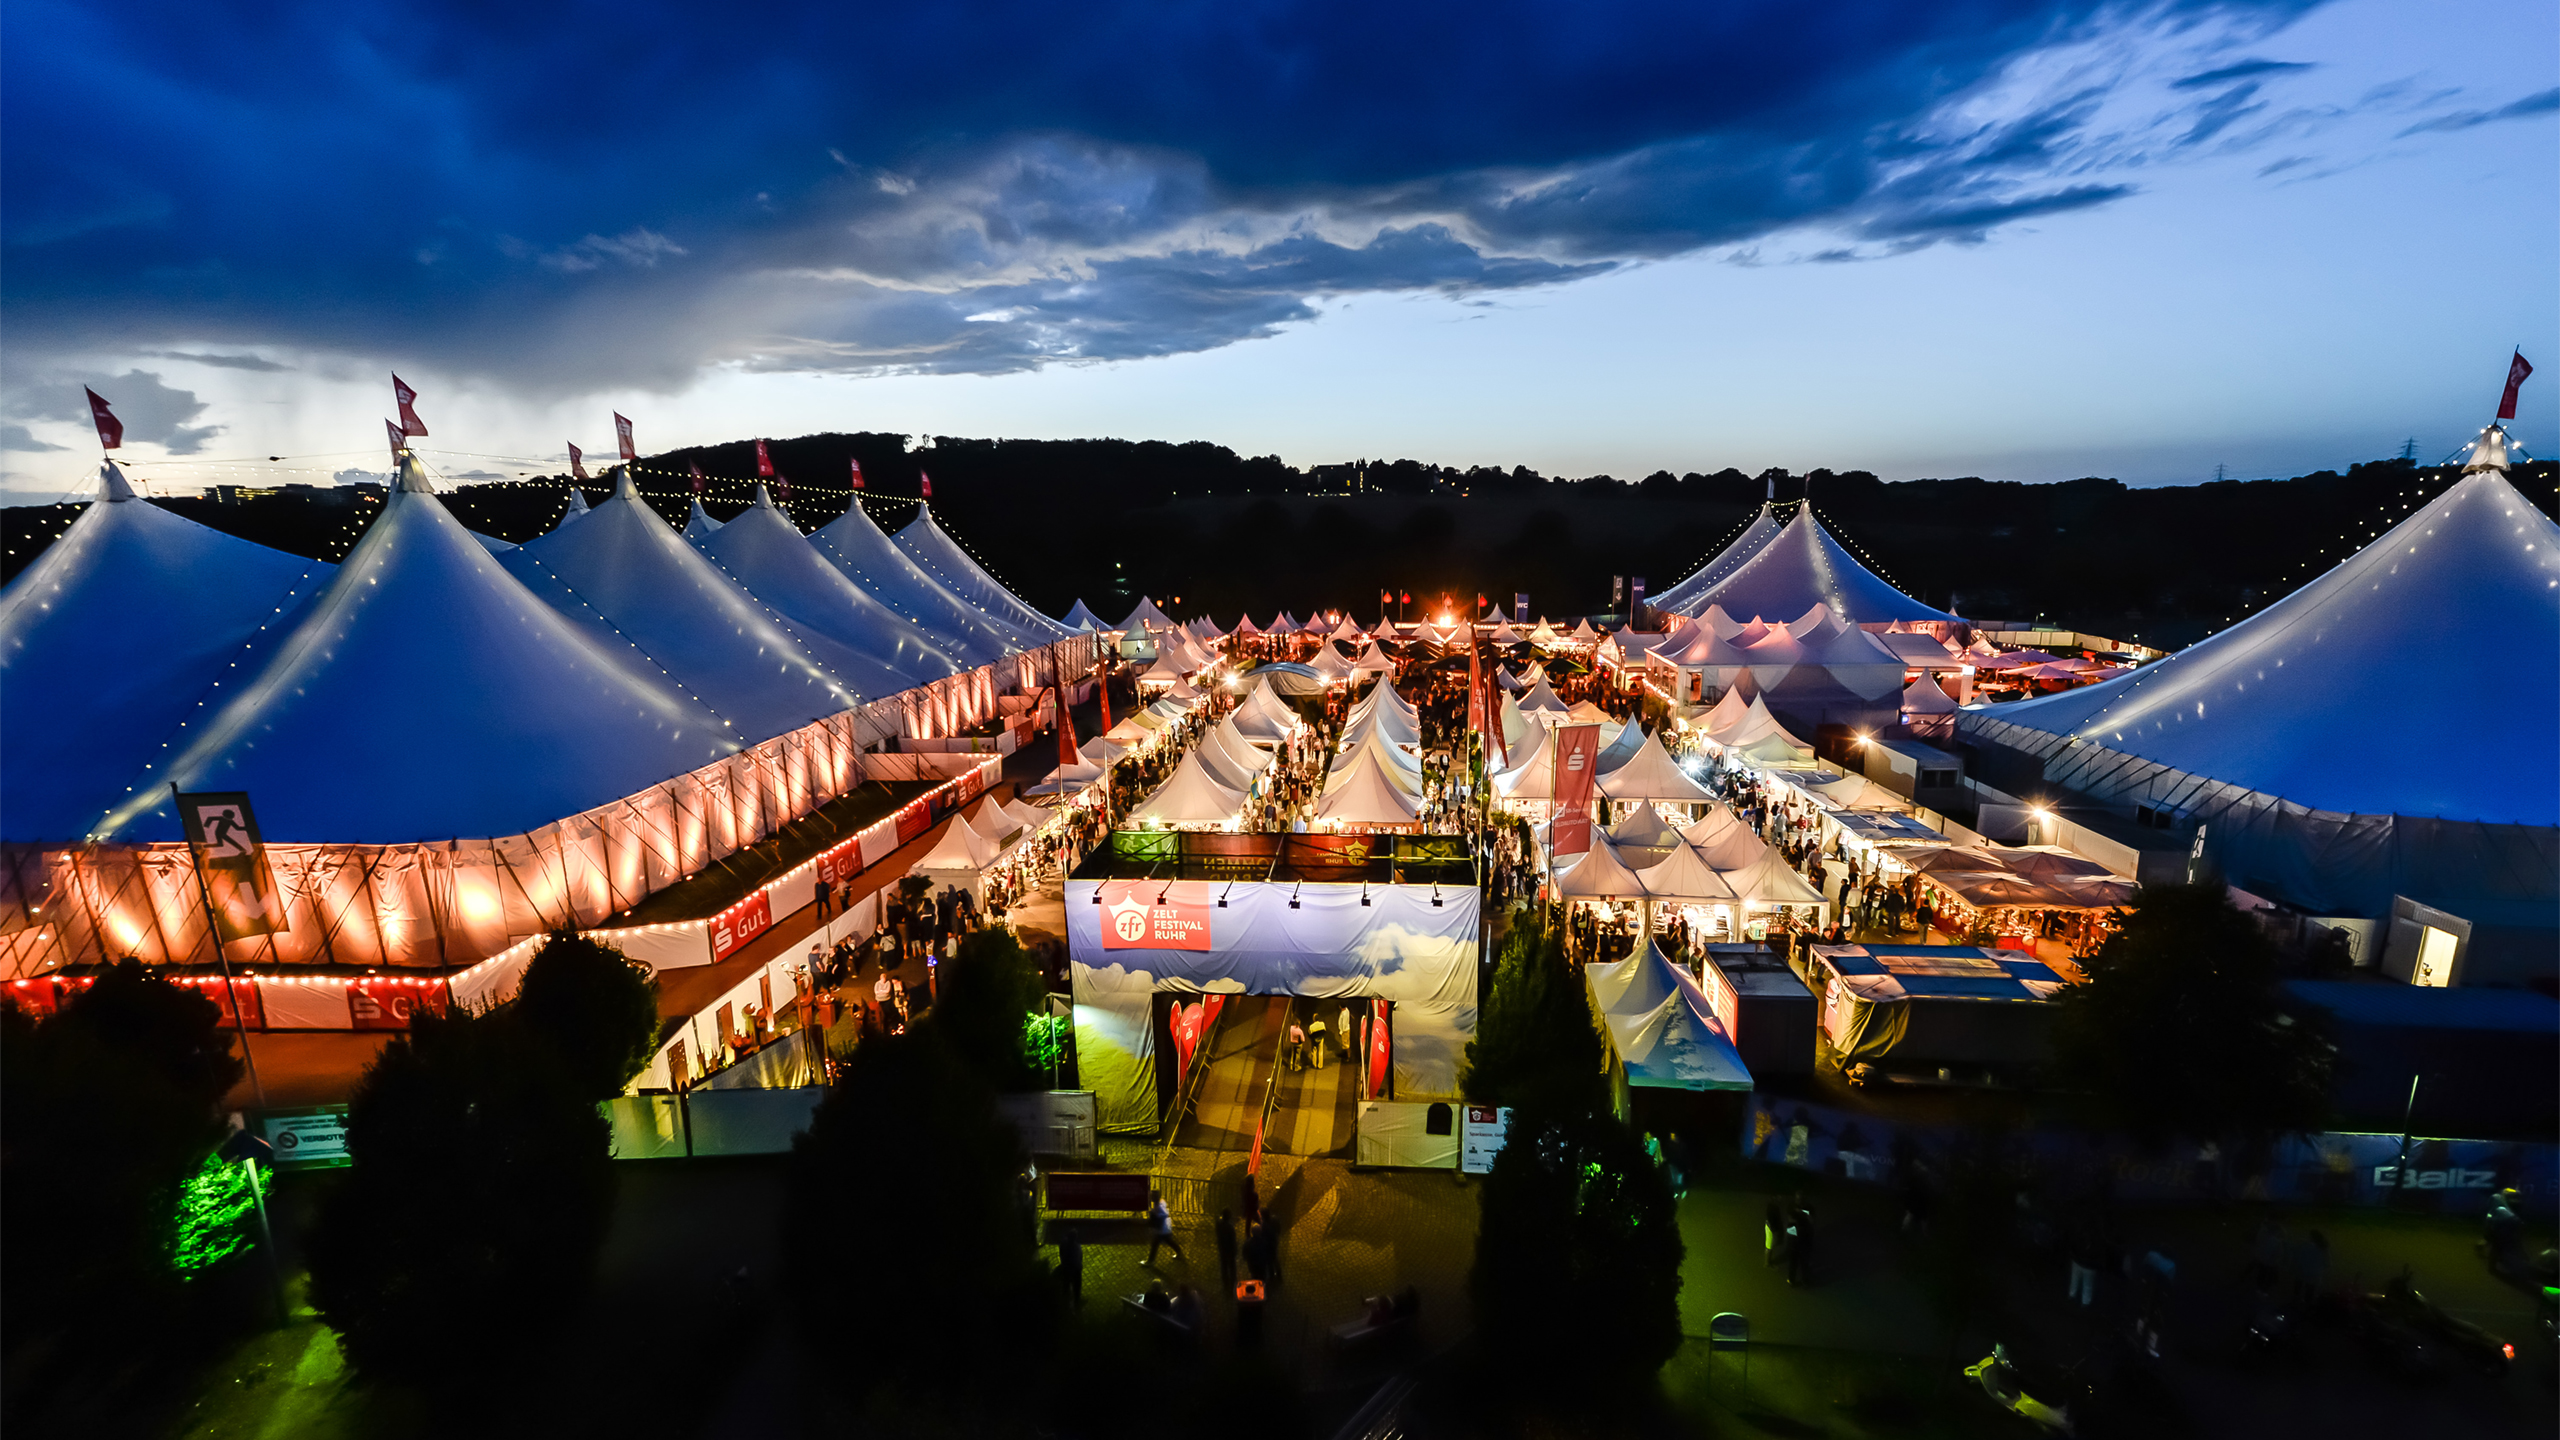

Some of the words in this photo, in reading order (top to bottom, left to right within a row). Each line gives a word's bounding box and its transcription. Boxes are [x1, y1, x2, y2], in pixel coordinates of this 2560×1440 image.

[1153, 909, 1178, 919] ZELT
[1120, 916, 1142, 939] zfr
[1154, 920, 1203, 931] FESTIVAL
[1154, 930, 1187, 940] RUHR
[1869, 1153, 1896, 1168] VON
[2107, 1152, 2195, 1189] Rock
[2373, 1166, 2497, 1189] Baltz
